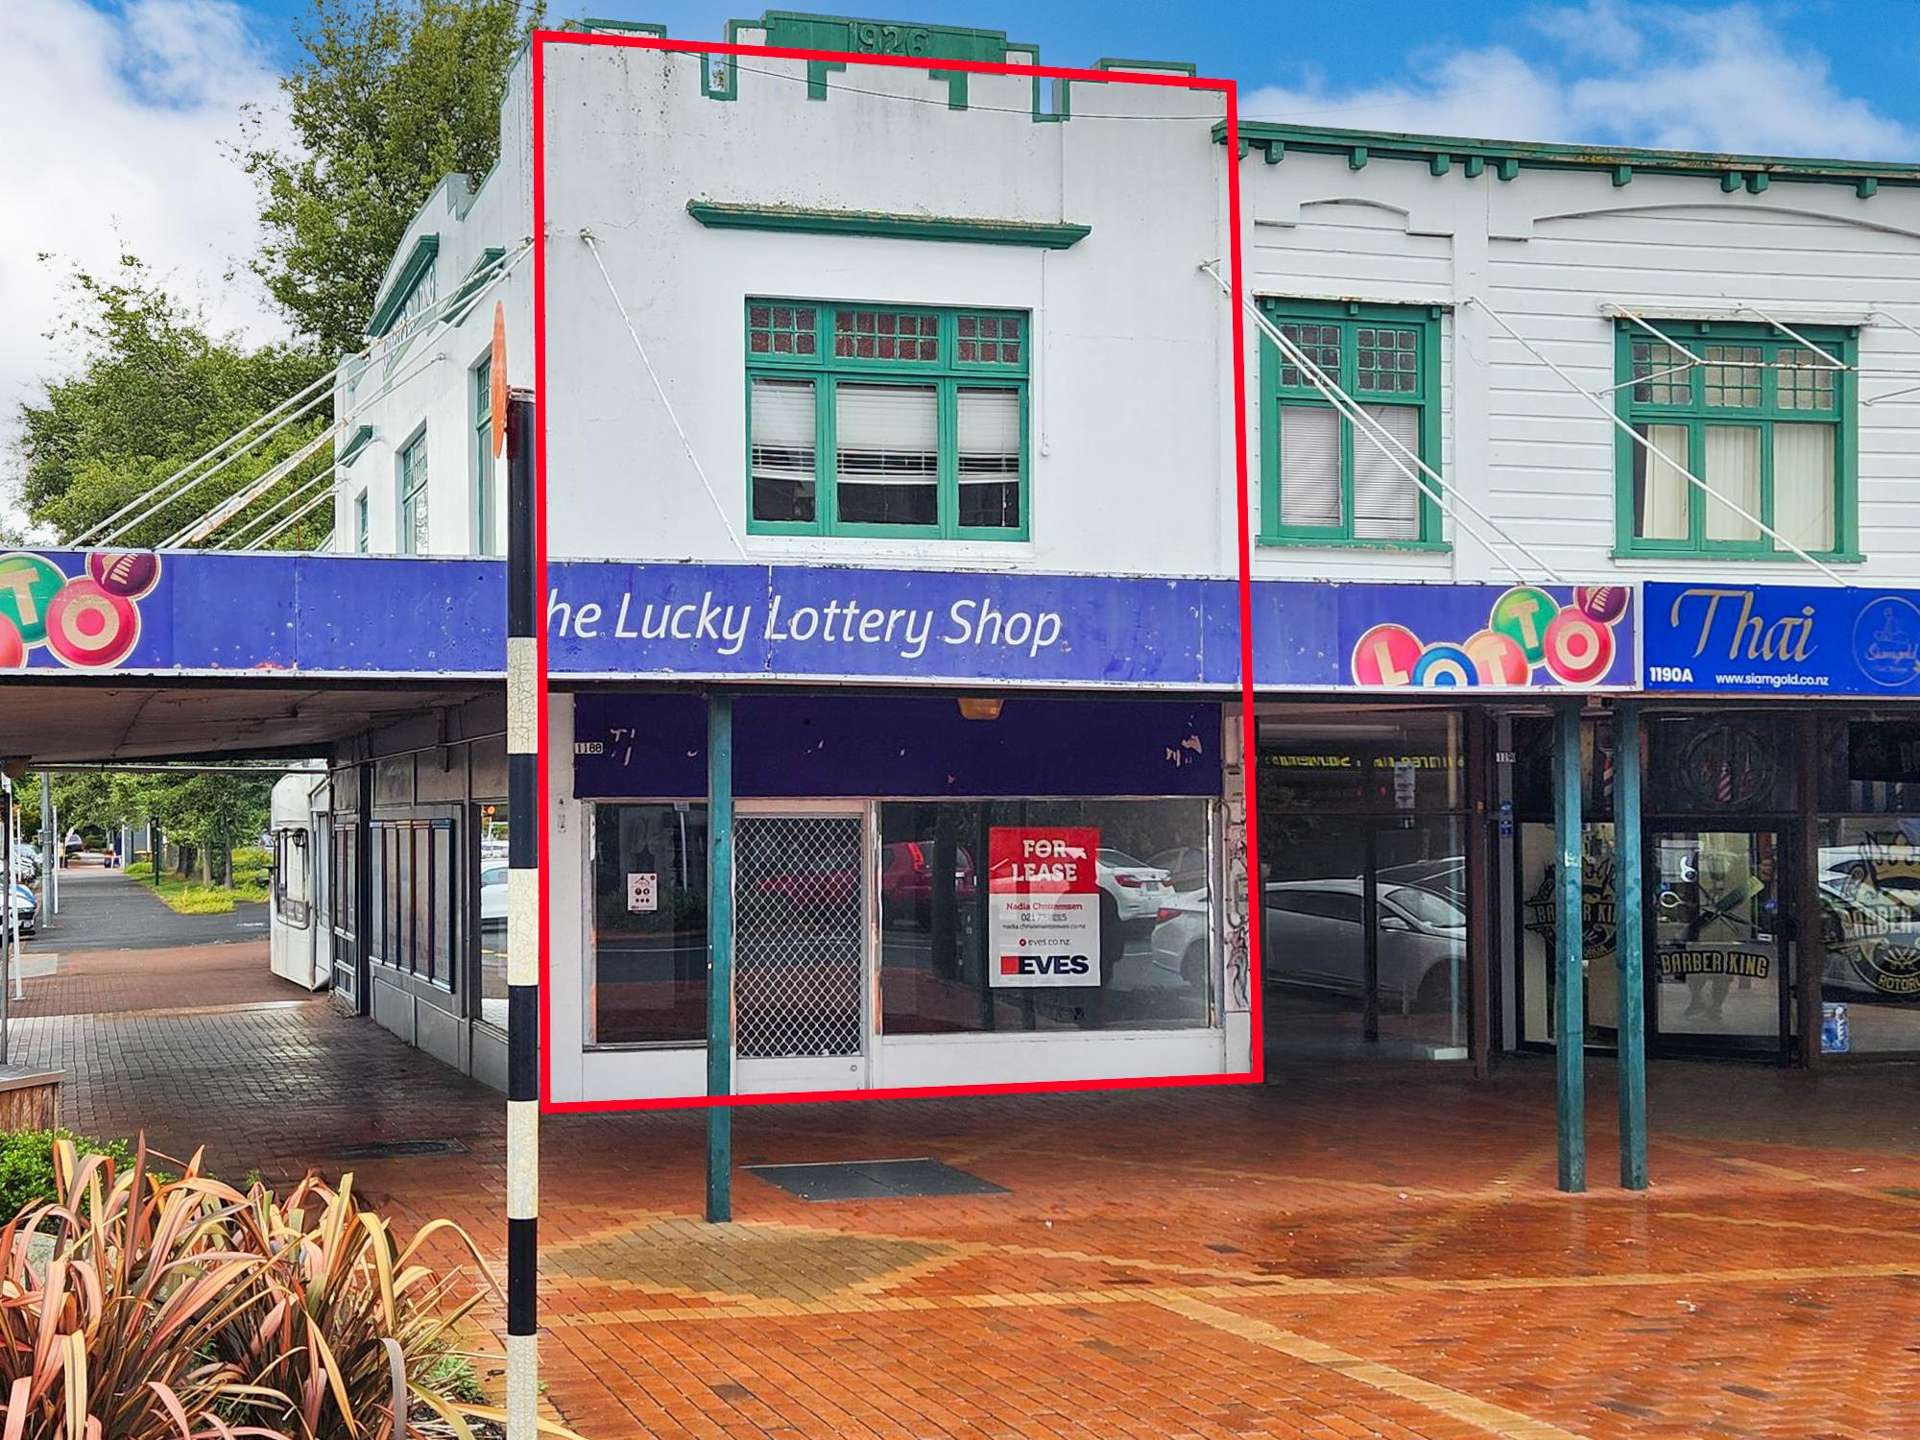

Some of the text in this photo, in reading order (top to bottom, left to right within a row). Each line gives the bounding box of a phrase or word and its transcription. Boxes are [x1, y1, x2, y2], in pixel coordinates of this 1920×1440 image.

[547, 588, 1062, 658] he Lucky Lottery Shop
[1671, 588, 1818, 662] Thai
[1373, 599, 1600, 686] LOTTO
[1650, 667, 1694, 683] 1190A
[1715, 672, 1829, 688] www.siamgold.co.nz
[577, 743, 602, 753] 1188
[1023, 839, 1068, 858] FOR
[1011, 863, 1077, 882] LEASE
[1018, 955, 1090, 975] EVES
[1661, 951, 1768, 978] BARBER KING
